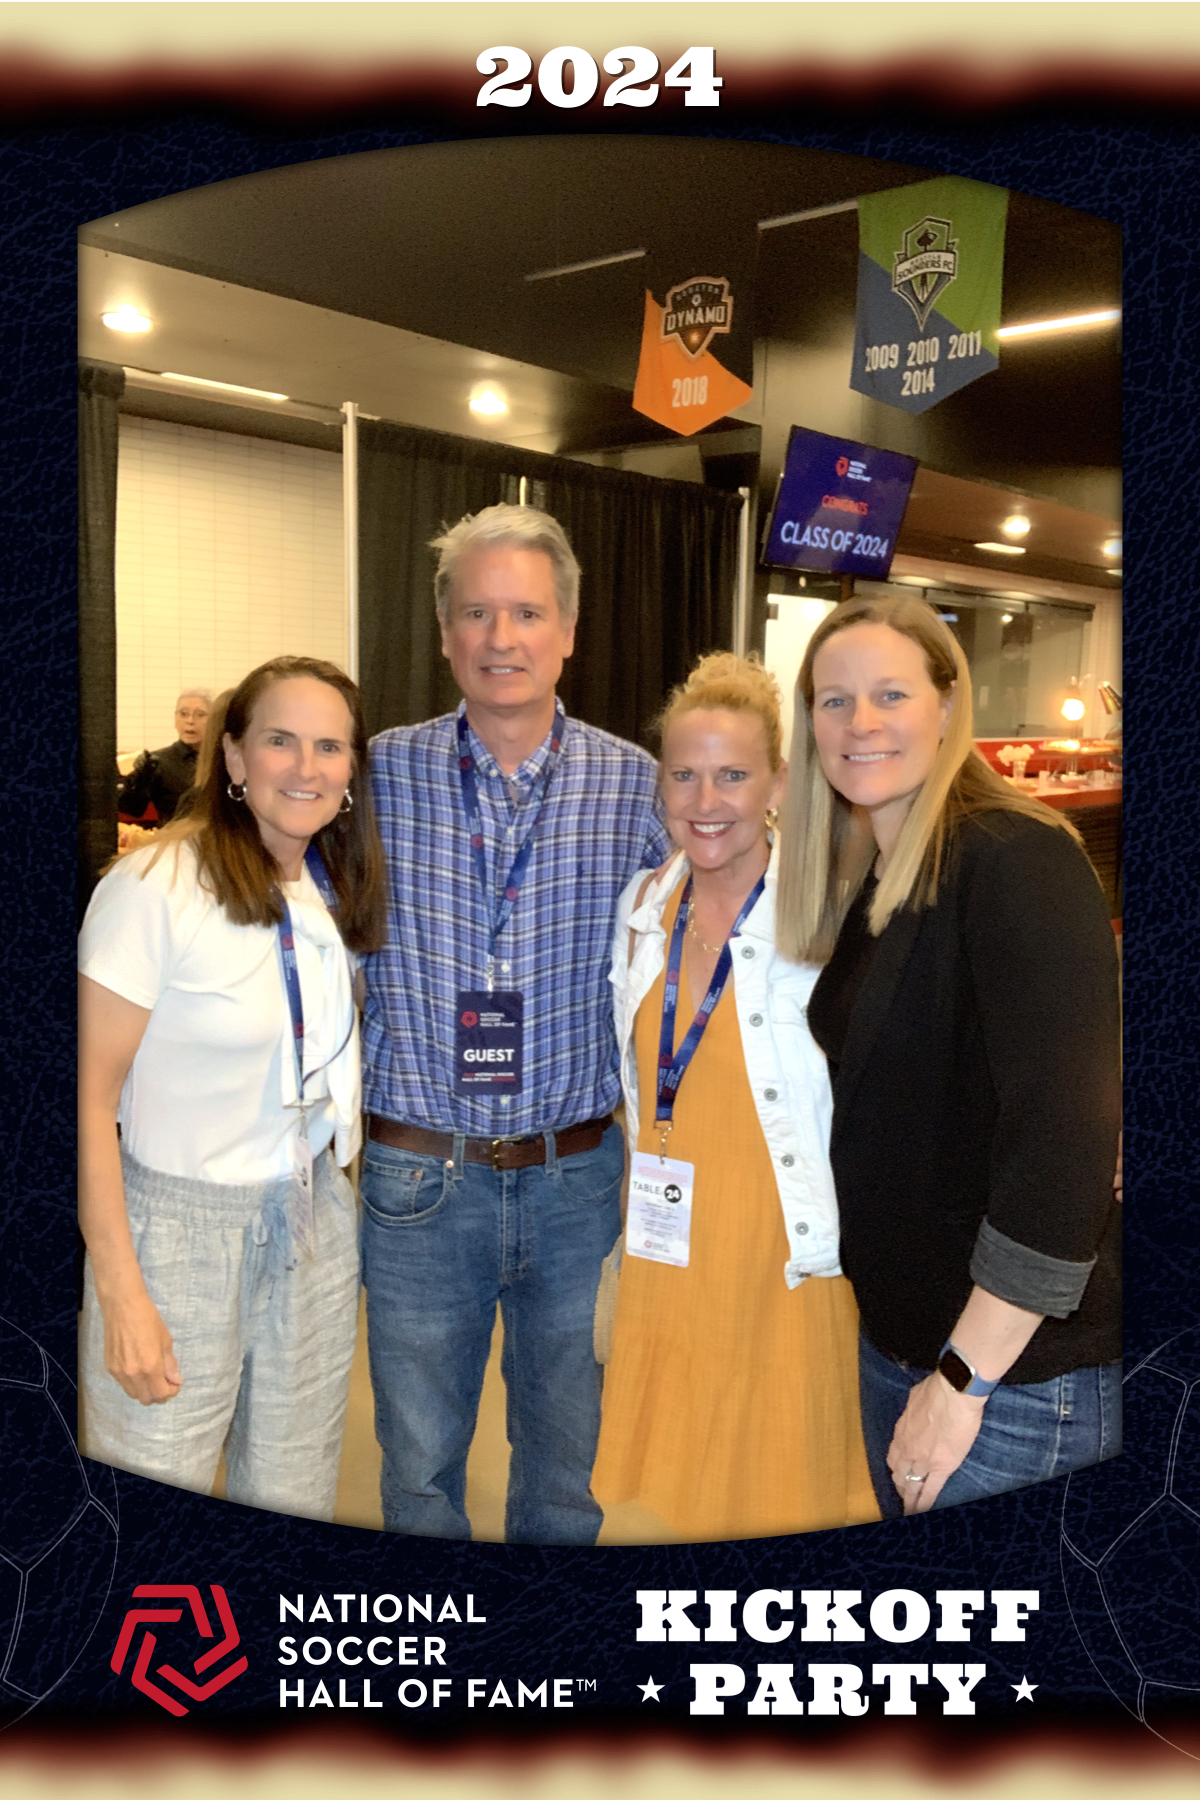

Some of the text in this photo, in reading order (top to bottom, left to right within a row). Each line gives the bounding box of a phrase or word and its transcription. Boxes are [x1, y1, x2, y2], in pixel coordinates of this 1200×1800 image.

[897, 259, 954, 281] SOUNDERS FC
[666, 305, 726, 332] DYNAMO
[865, 329, 982, 372] 2009 2010 2011
[671, 375, 709, 408] 2018
[901, 366, 936, 396] 2014
[780, 520, 890, 559] CLASS OF 2024
[463, 1048, 515, 1063] GUEST
[666, 1188, 680, 1200] 24
